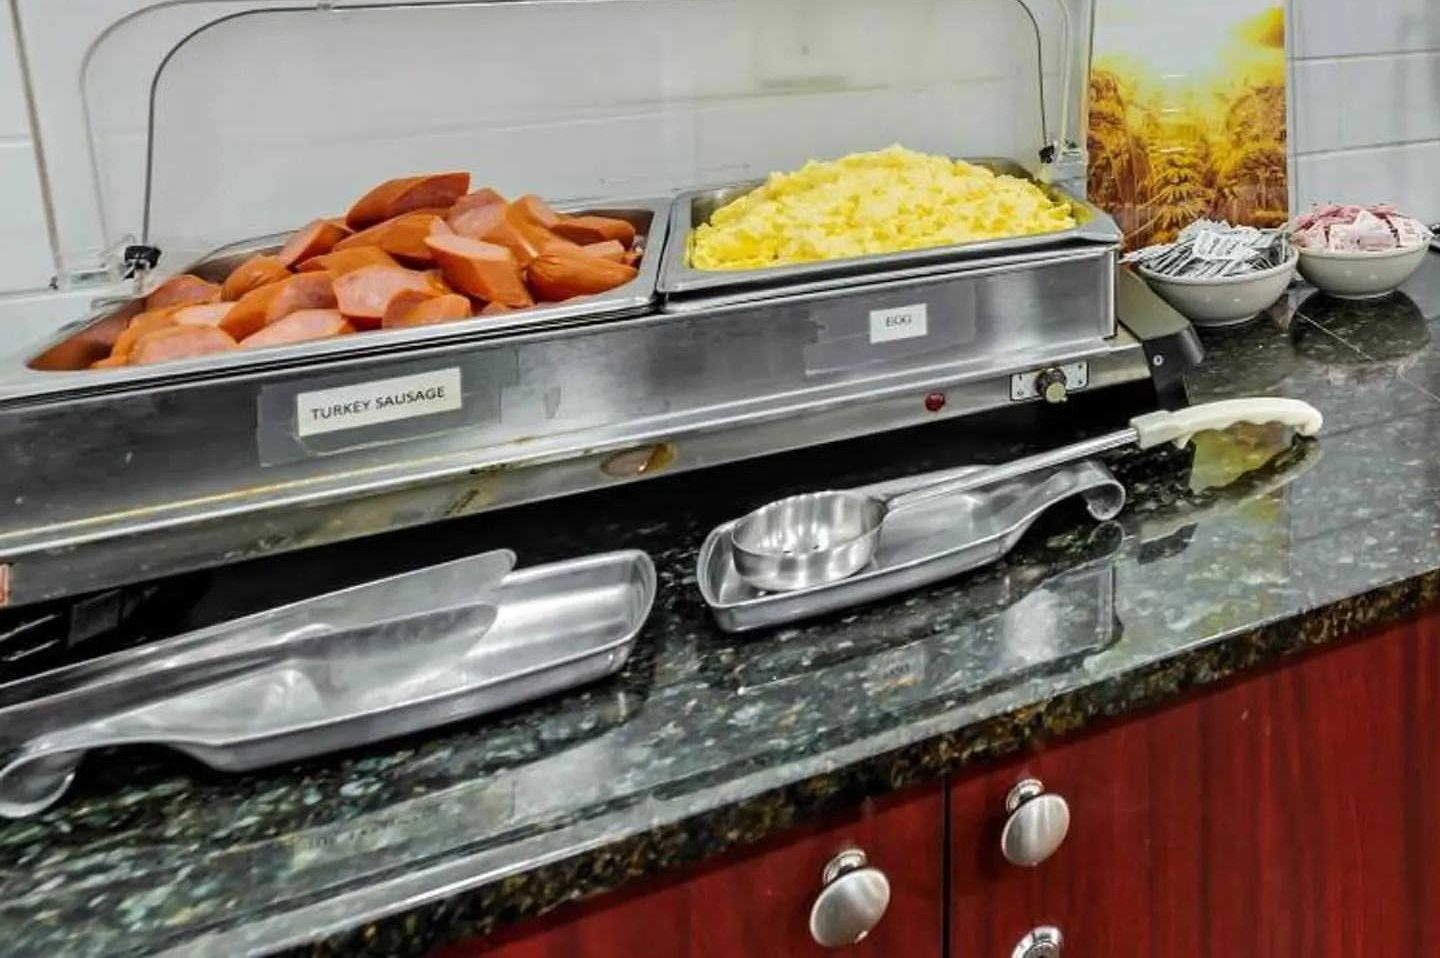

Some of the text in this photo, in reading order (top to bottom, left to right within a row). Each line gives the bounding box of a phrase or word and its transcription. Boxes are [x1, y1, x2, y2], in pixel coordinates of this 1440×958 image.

[885, 314, 913, 328] EGG
[310, 385, 446, 422] TURKEY SAUSAGE
